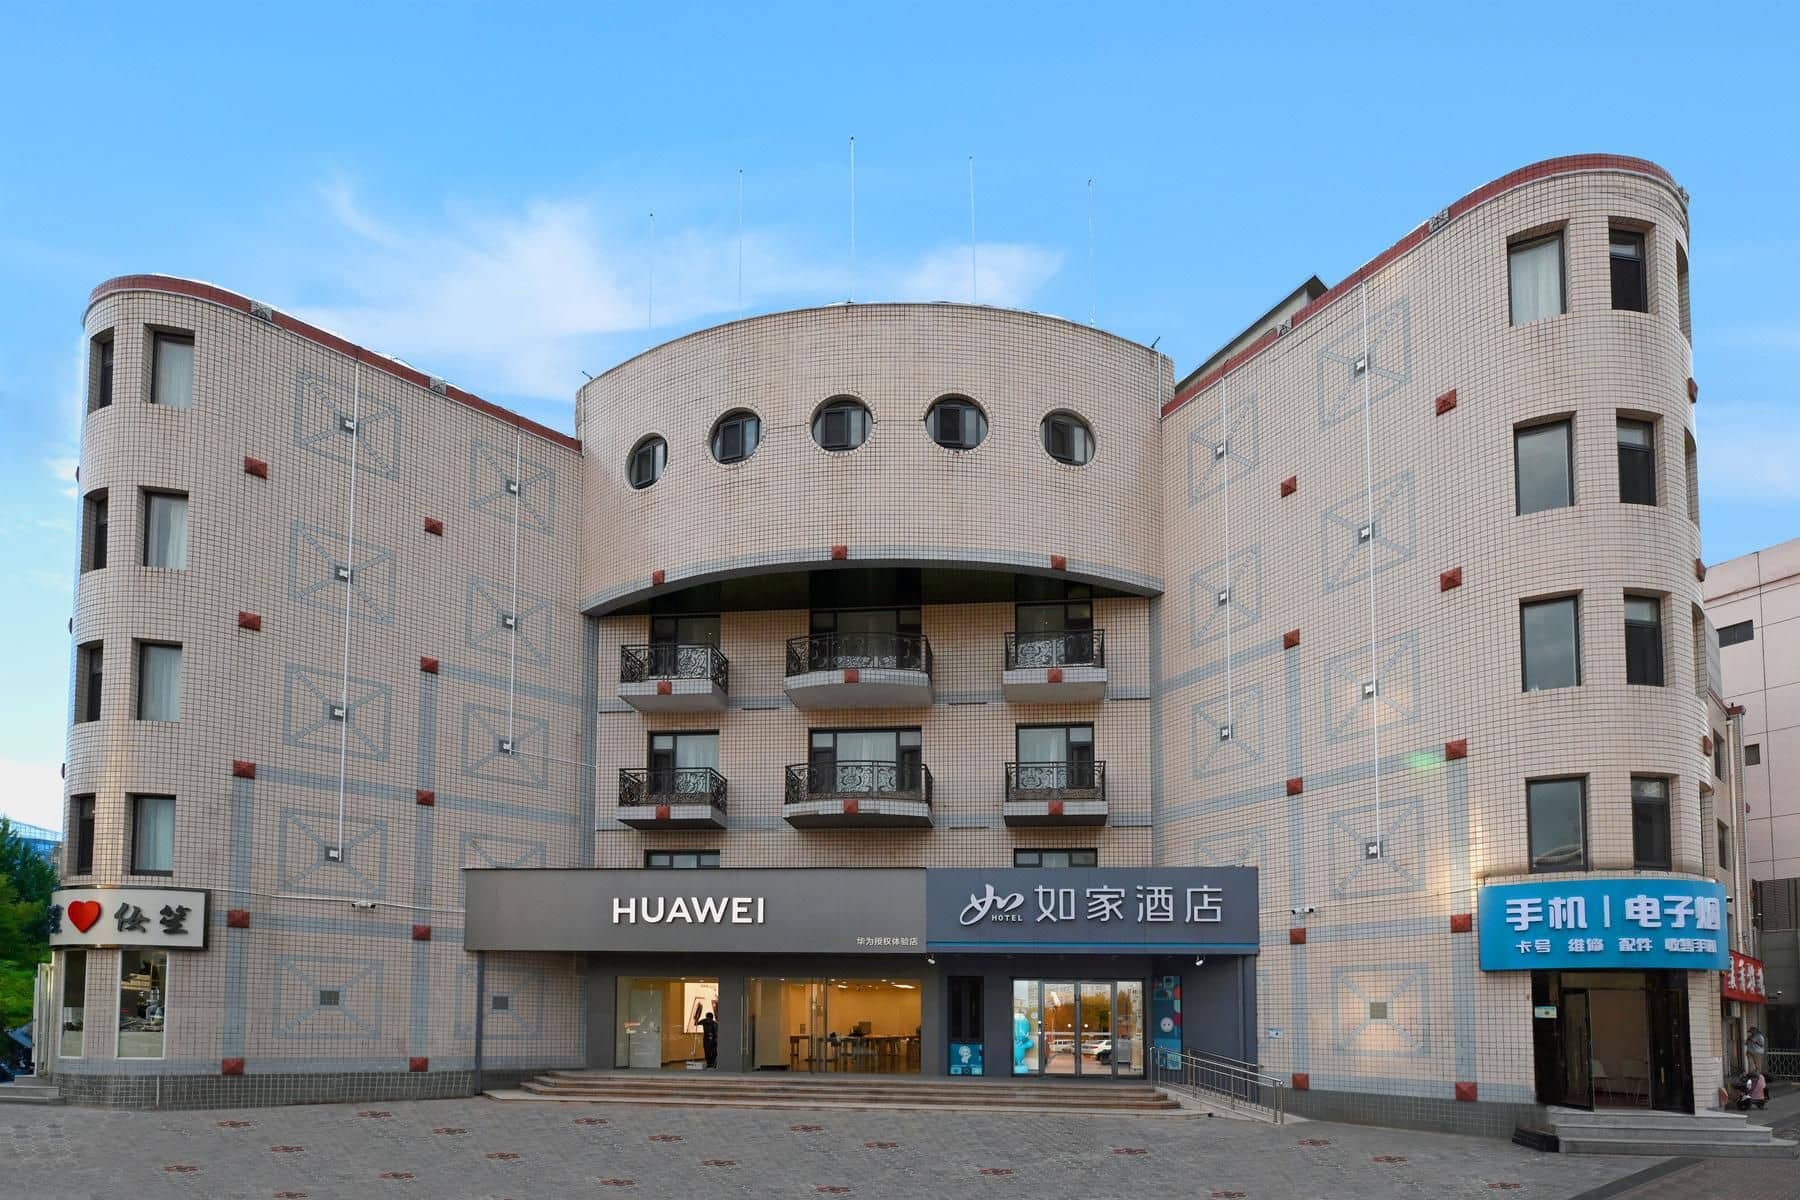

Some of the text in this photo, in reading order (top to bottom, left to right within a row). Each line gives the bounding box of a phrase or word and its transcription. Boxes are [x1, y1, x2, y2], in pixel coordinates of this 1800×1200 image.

[612, 896, 765, 924] HUAWEI
[1034, 884, 1223, 923] 如家酒店
[1505, 894, 1721, 932] 手机 电子烟
[991, 914, 1023, 922] HOTEL
[856, 936, 918, 946] 华为授权体验店
[1515, 938, 1551, 954] 卡号
[1568, 938, 1604, 953] 维修
[1618, 937, 1653, 953] 配件
